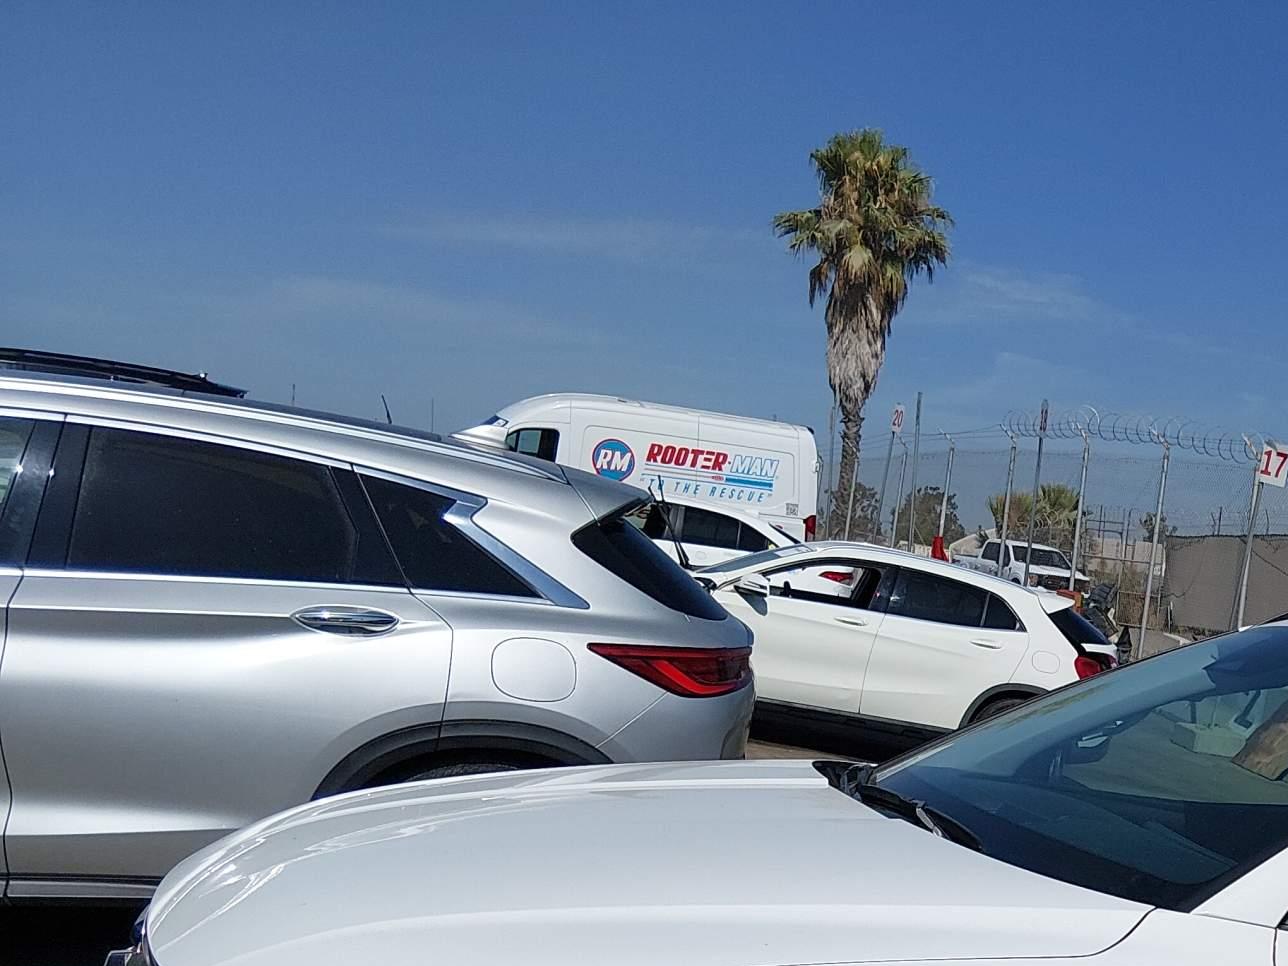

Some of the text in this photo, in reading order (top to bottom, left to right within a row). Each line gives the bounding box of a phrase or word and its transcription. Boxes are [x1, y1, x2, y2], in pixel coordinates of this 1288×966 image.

[596, 449, 632, 472] RM
[1260, 450, 1288, 478] 17
[674, 482, 701, 496] THE
